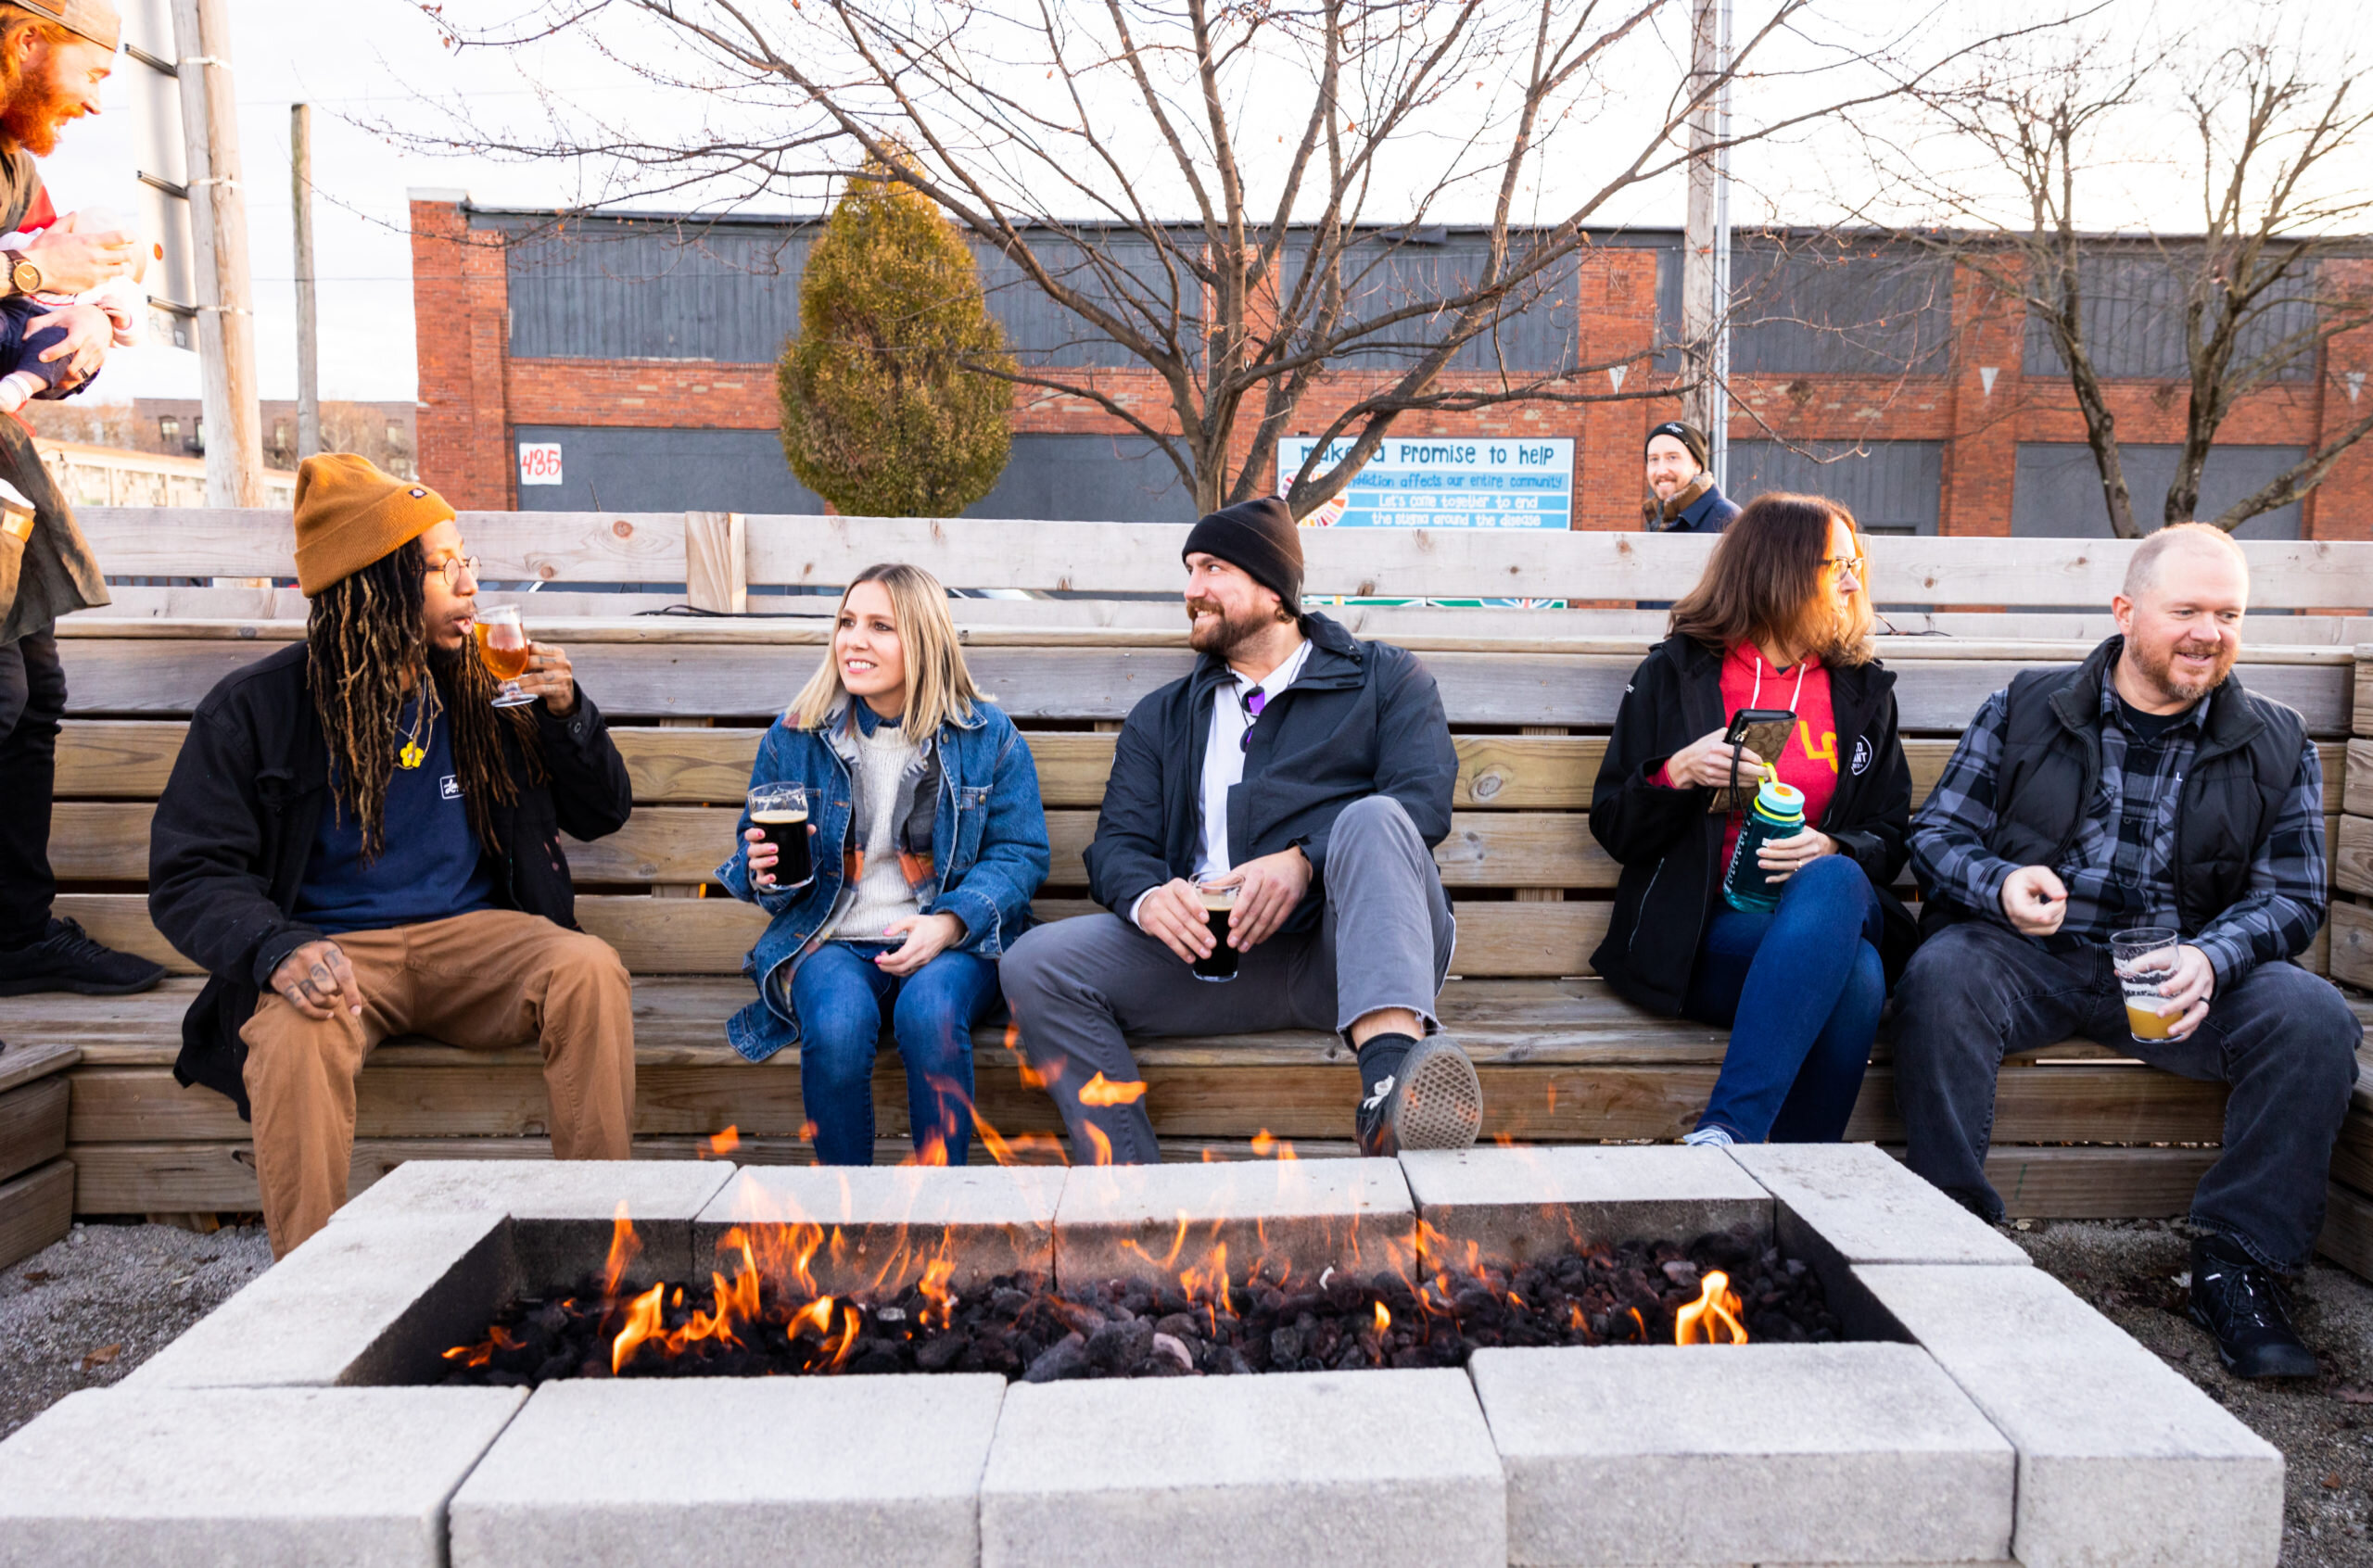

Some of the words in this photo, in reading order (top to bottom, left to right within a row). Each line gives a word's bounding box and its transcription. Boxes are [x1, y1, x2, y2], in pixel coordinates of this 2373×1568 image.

[522, 449, 562, 476] 435
[1489, 446, 1507, 464] to
[1519, 445, 1555, 466] help
[1350, 473, 1394, 488] ddiction
[1400, 474, 1442, 488] affects
[1447, 475, 1465, 487] our
[1470, 474, 1504, 488] entire
[1510, 475, 1563, 489] community
[1378, 494, 1406, 508] Let's
[1409, 495, 1437, 508] come
[1440, 494, 1491, 510] together
[1495, 496, 1511, 510] to
[1515, 496, 1539, 510] end
[1372, 512, 1393, 525] the
[1433, 513, 1470, 526] around
[1475, 514, 1496, 527] the
[1500, 515, 1542, 527] disease
